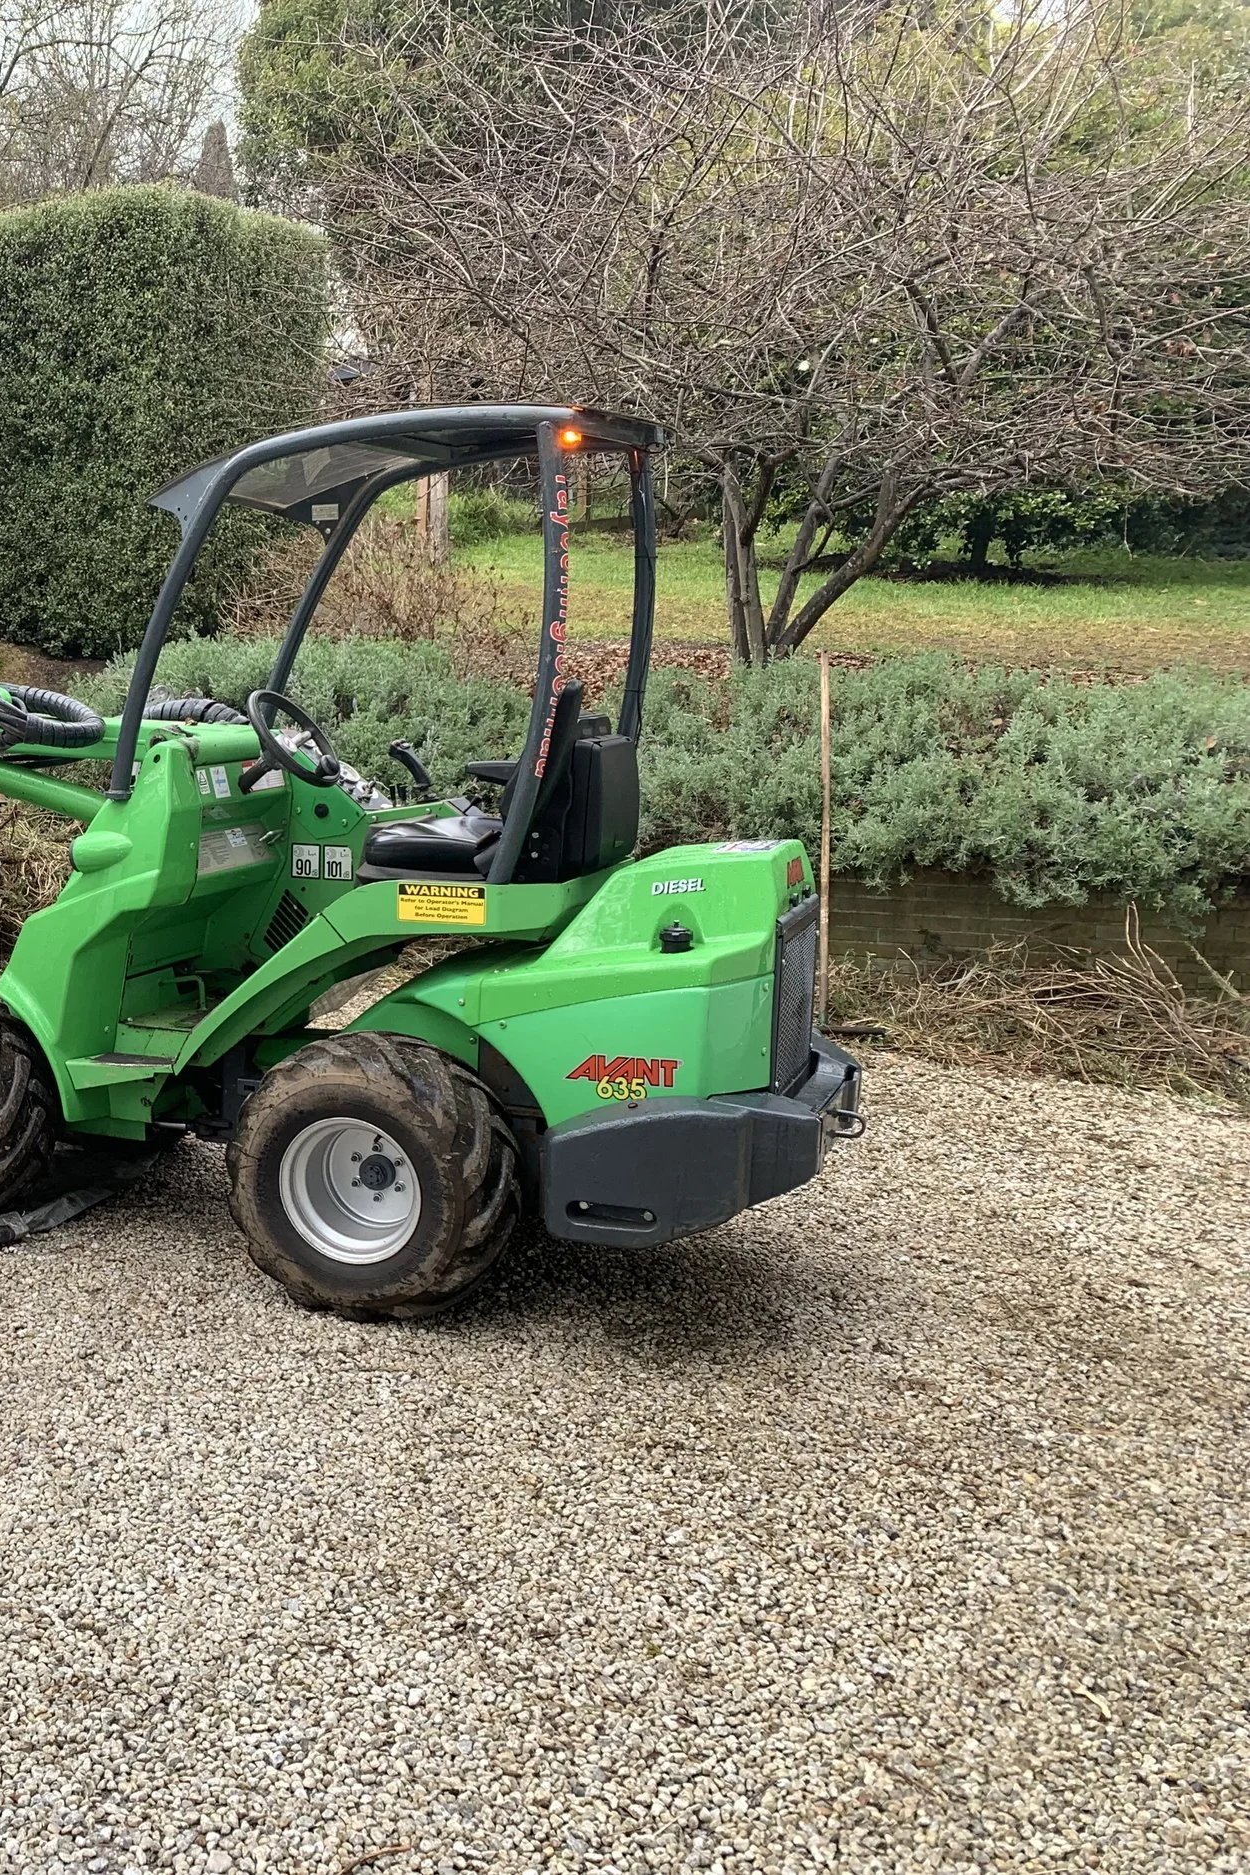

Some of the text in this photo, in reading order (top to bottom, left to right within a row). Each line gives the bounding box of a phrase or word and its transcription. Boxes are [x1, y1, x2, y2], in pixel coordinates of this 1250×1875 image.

[296, 858, 311, 876] 90
[326, 860, 342, 878] 101
[404, 884, 479, 898] WARNING
[651, 878, 707, 896] DIESEL
[564, 1053, 679, 1089] AVANT
[596, 1075, 648, 1100] 635
